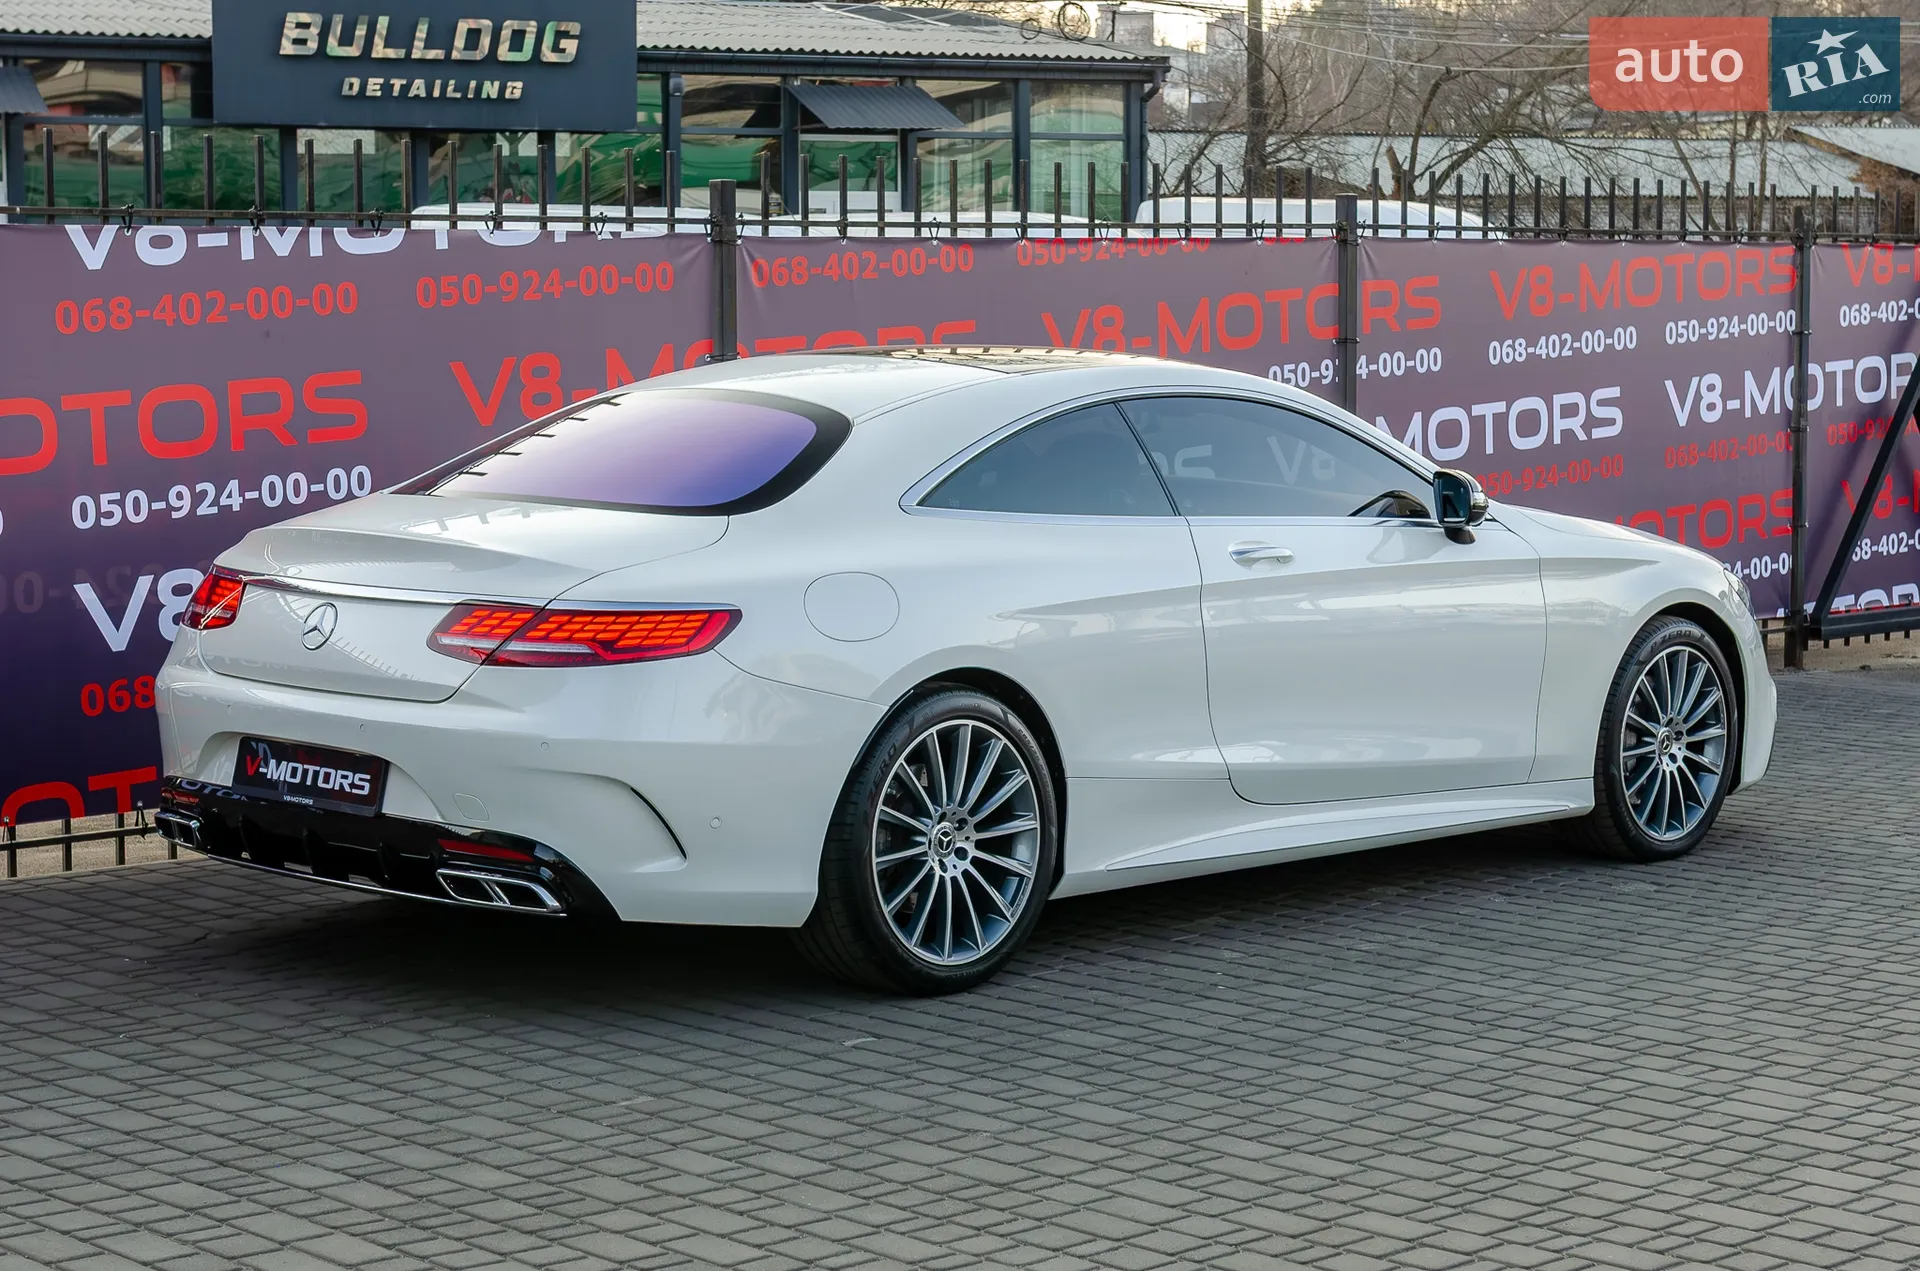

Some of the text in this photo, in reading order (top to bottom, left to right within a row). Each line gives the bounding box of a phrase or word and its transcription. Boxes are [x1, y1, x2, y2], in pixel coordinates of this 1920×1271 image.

[279, 12, 581, 63] BULLDOG
[341, 77, 525, 100] DETAILING
[416, 261, 675, 308] 050-924-00-00
[752, 243, 974, 288] 068-402-00-00
[1489, 246, 1797, 321] V8-MOTORS
[1840, 242, 1920, 288] V8-
[55, 281, 359, 334] 068-402-00-00
[1665, 309, 1796, 345] 050-924-00-00
[1268, 347, 1442, 388] 050-94-00-00
[1489, 326, 1637, 366] 068-402-00-00
[71, 465, 372, 530] 050-924-00-00
